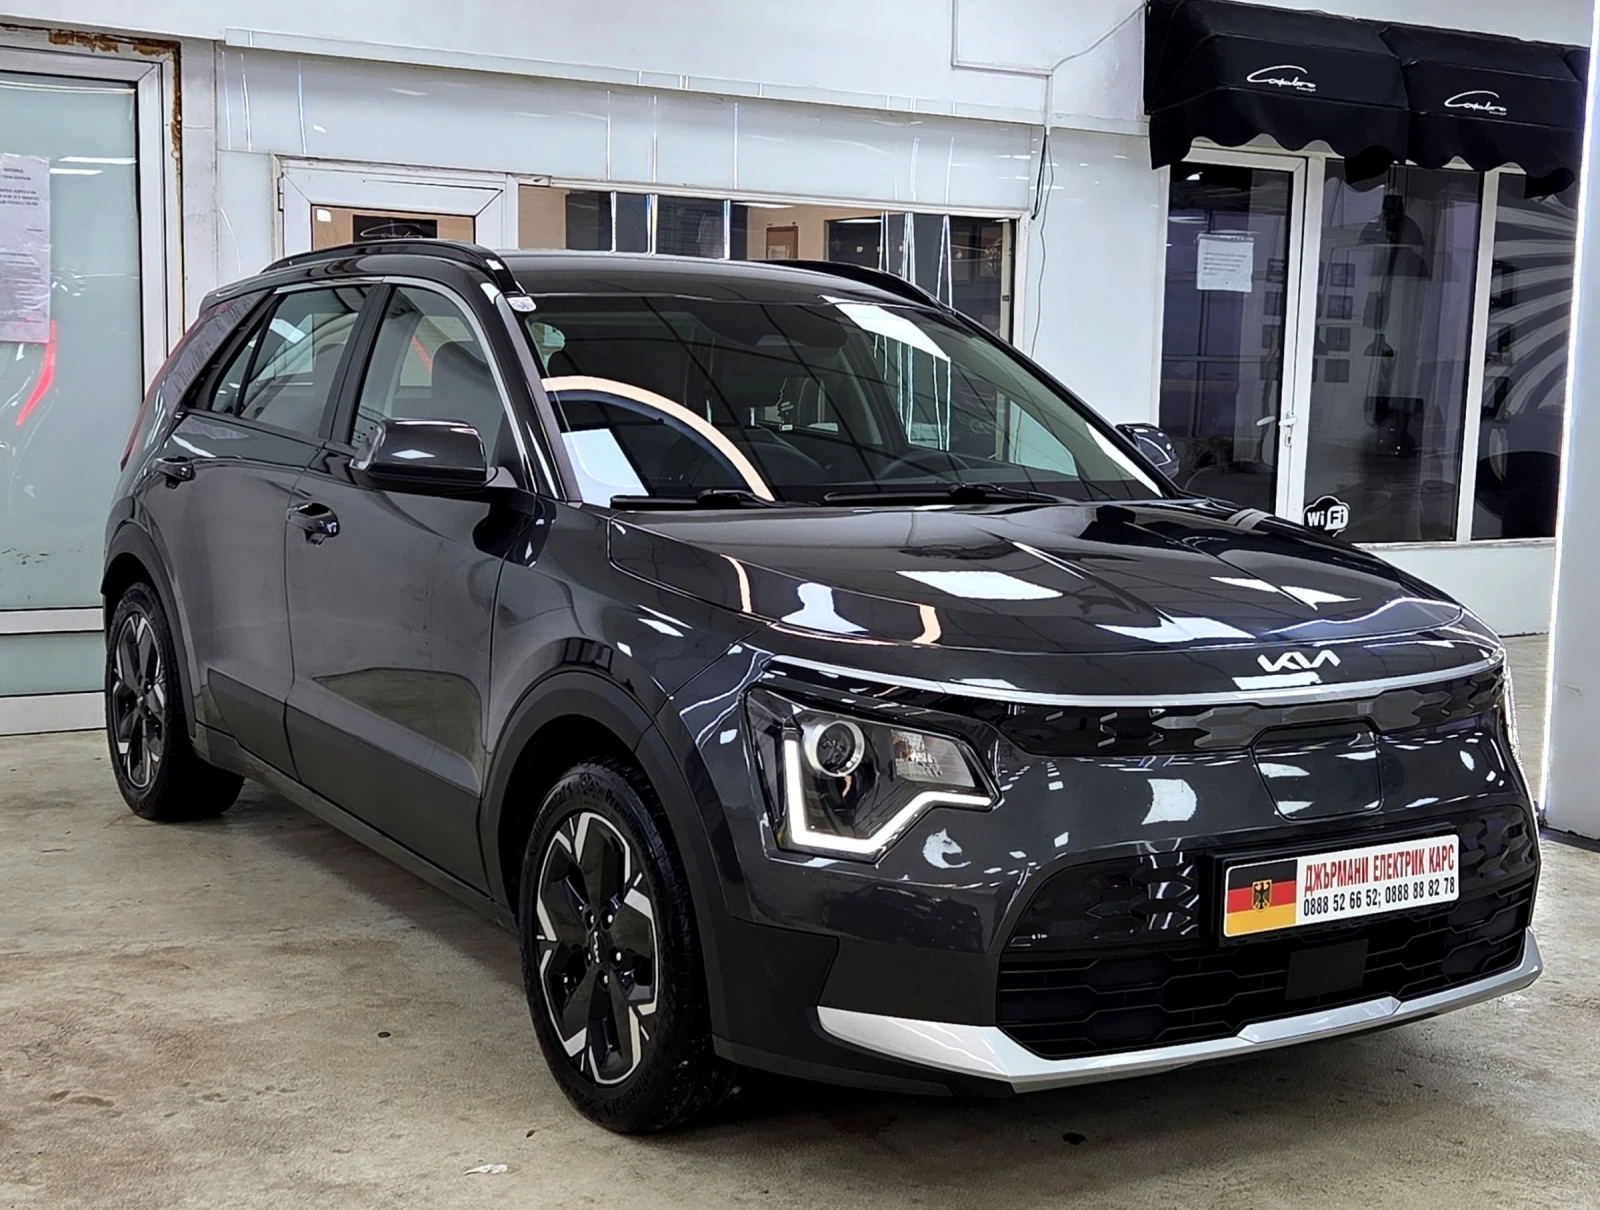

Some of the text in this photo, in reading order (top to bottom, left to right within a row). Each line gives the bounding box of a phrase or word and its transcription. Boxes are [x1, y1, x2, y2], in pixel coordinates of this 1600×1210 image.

[1257, 649, 1341, 672] KIA
[1304, 843, 1454, 897] ДЖЪРМАНИ ЕЛЕКТРИК КАРС
[1303, 876, 1455, 917] 0888 52 66 52; 0888 88 82 78
